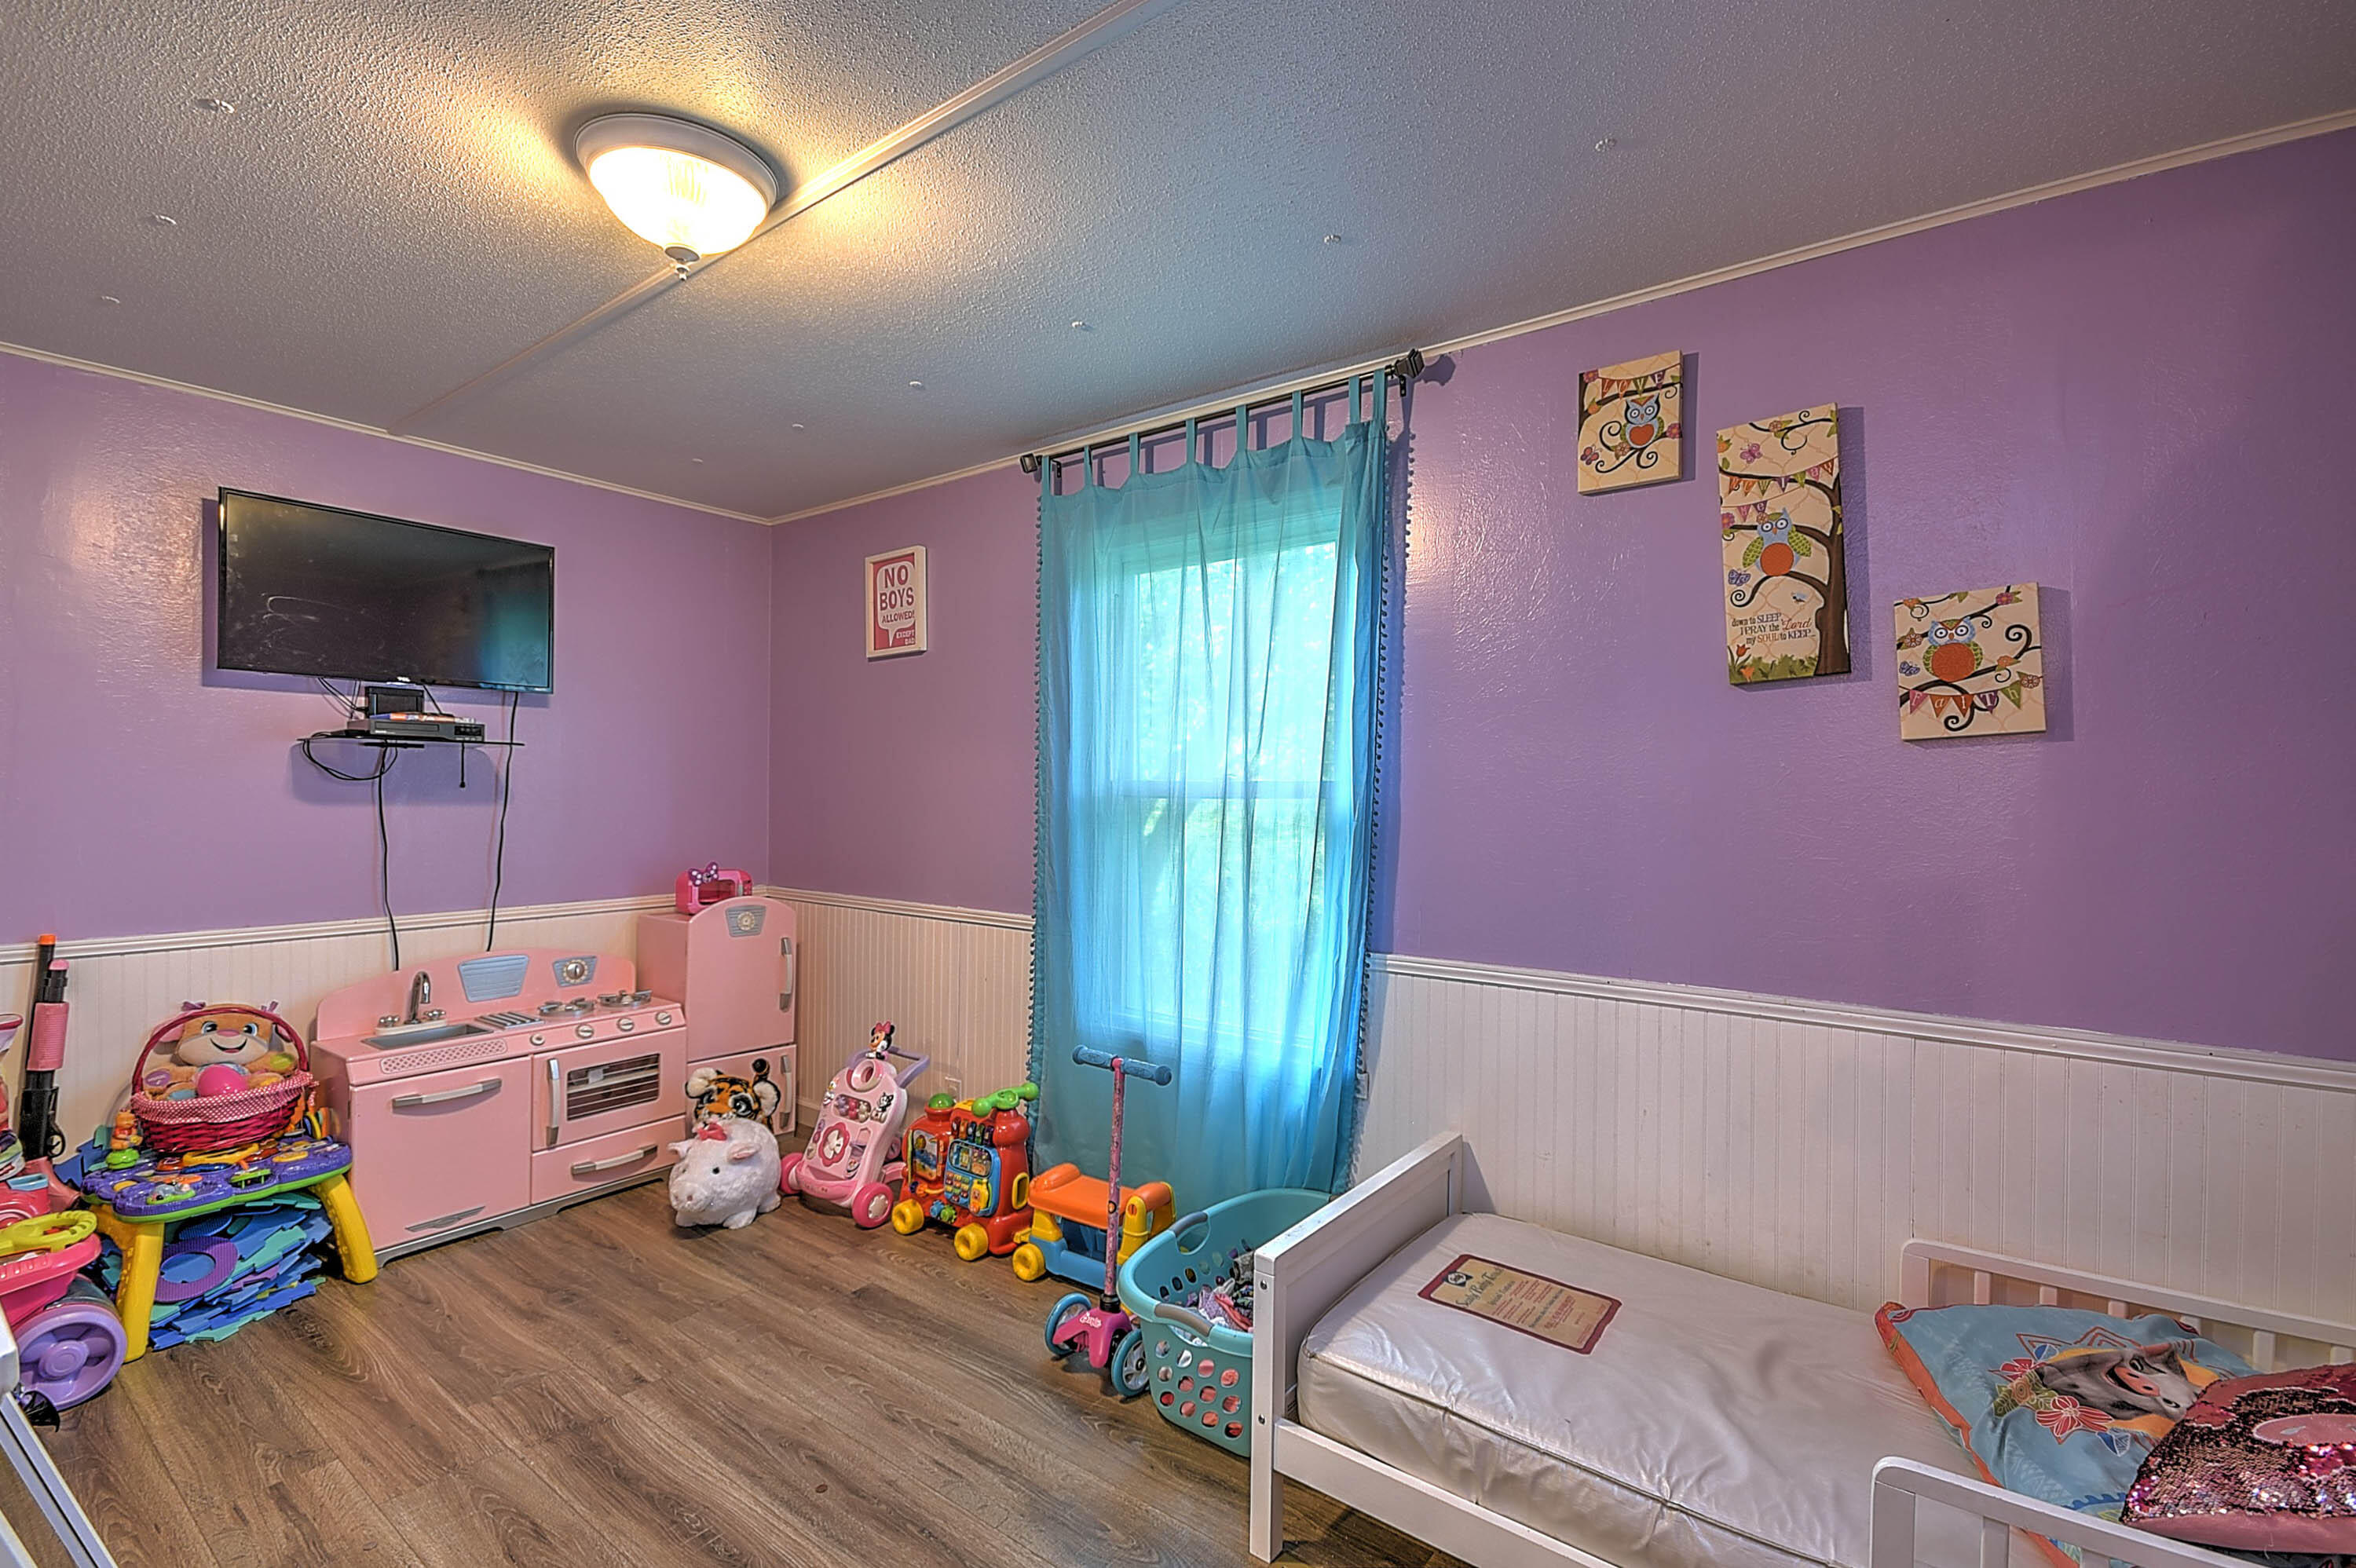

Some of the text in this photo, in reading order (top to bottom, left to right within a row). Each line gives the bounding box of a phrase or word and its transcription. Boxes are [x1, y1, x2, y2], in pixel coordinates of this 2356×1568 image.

[884, 565, 909, 588] NO
[880, 587, 914, 611] BOYS
[881, 610, 915, 623] ALLOWED!
[1732, 618, 1748, 627] down
[1745, 623, 1768, 634] PRAY
[1769, 623, 1780, 632] the
[1781, 618, 1812, 631] Lord
[1746, 637, 1756, 645] my
[1757, 634, 1779, 643] SOUL
[1780, 632, 1787, 641] to
